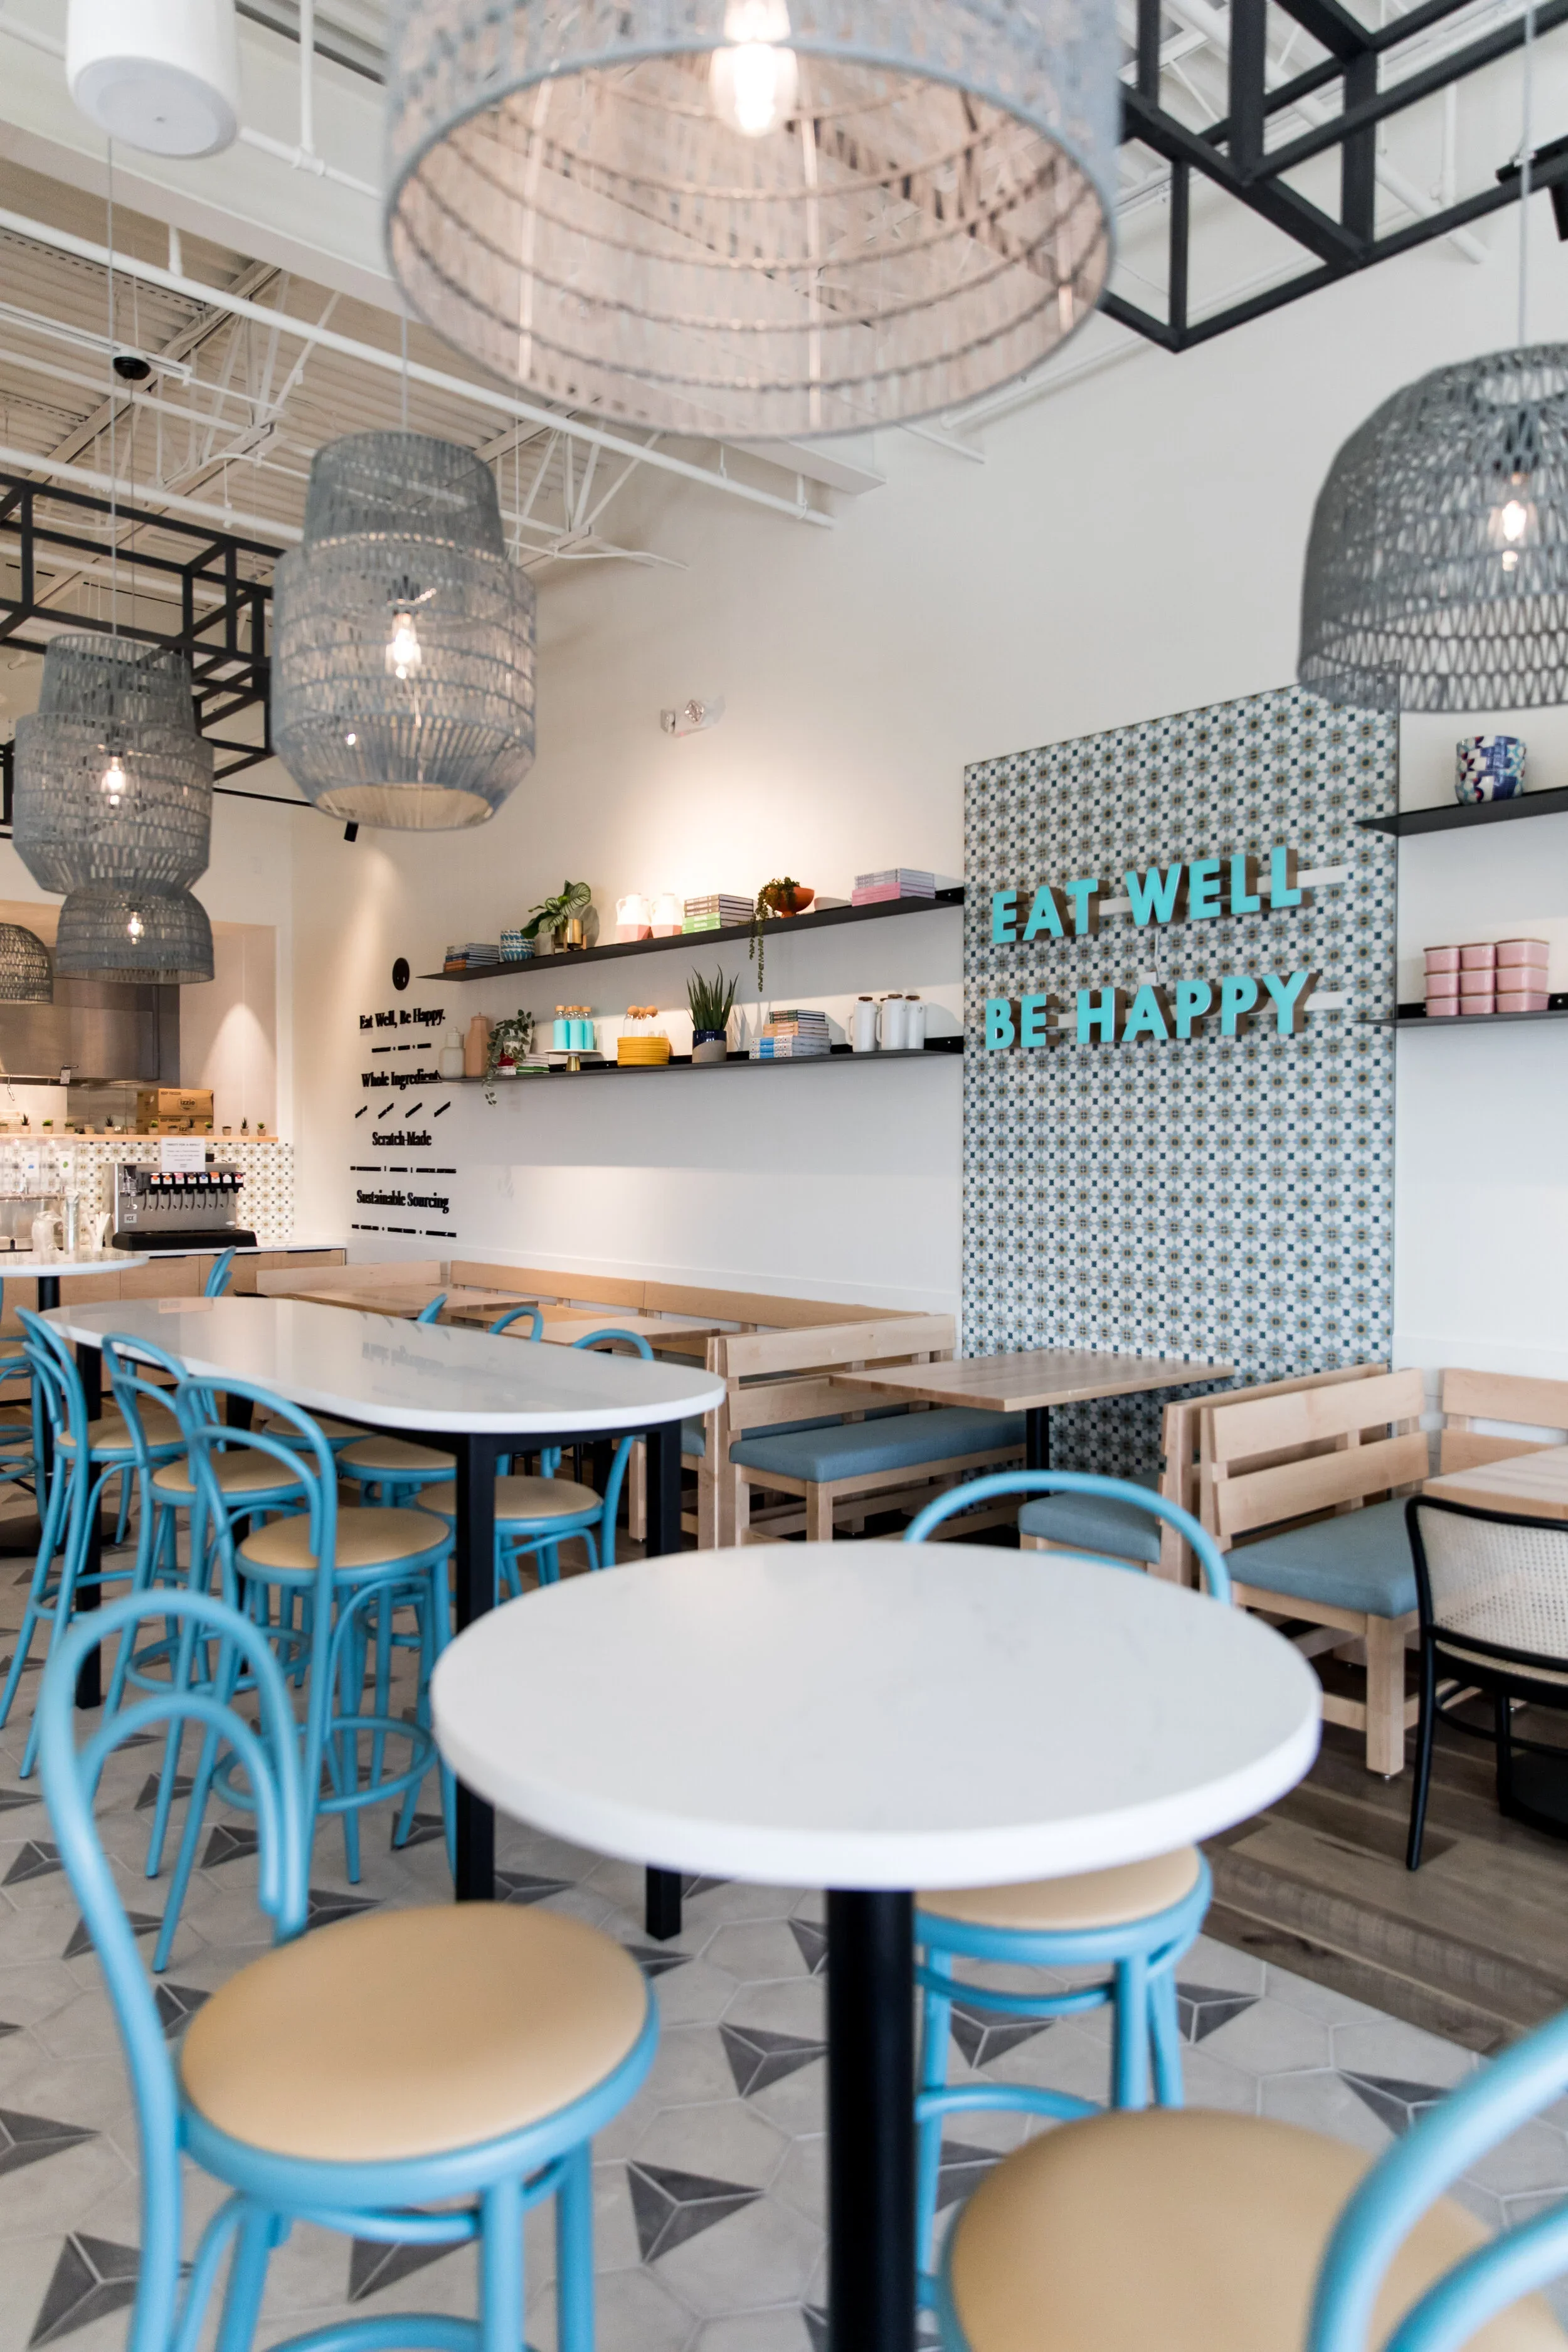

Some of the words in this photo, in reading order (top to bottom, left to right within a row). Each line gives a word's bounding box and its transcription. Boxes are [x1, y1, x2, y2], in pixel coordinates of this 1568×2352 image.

[992, 878, 1099, 945] EAT
[1125, 845, 1302, 926] WELL
[359, 1015, 373, 1029] Eat
[374, 1010, 398, 1028] Well,
[400, 1010, 411, 1024] Be
[413, 1007, 446, 1027] Happy.
[985, 993, 1047, 1051] BE
[1076, 972, 1310, 1045] HAPPY
[361, 1071, 389, 1087] Whole
[372, 1130, 432, 1146] Scratch-Made
[357, 1189, 406, 1206] Sustainable
[408, 1192, 449, 1214] Sourcing
